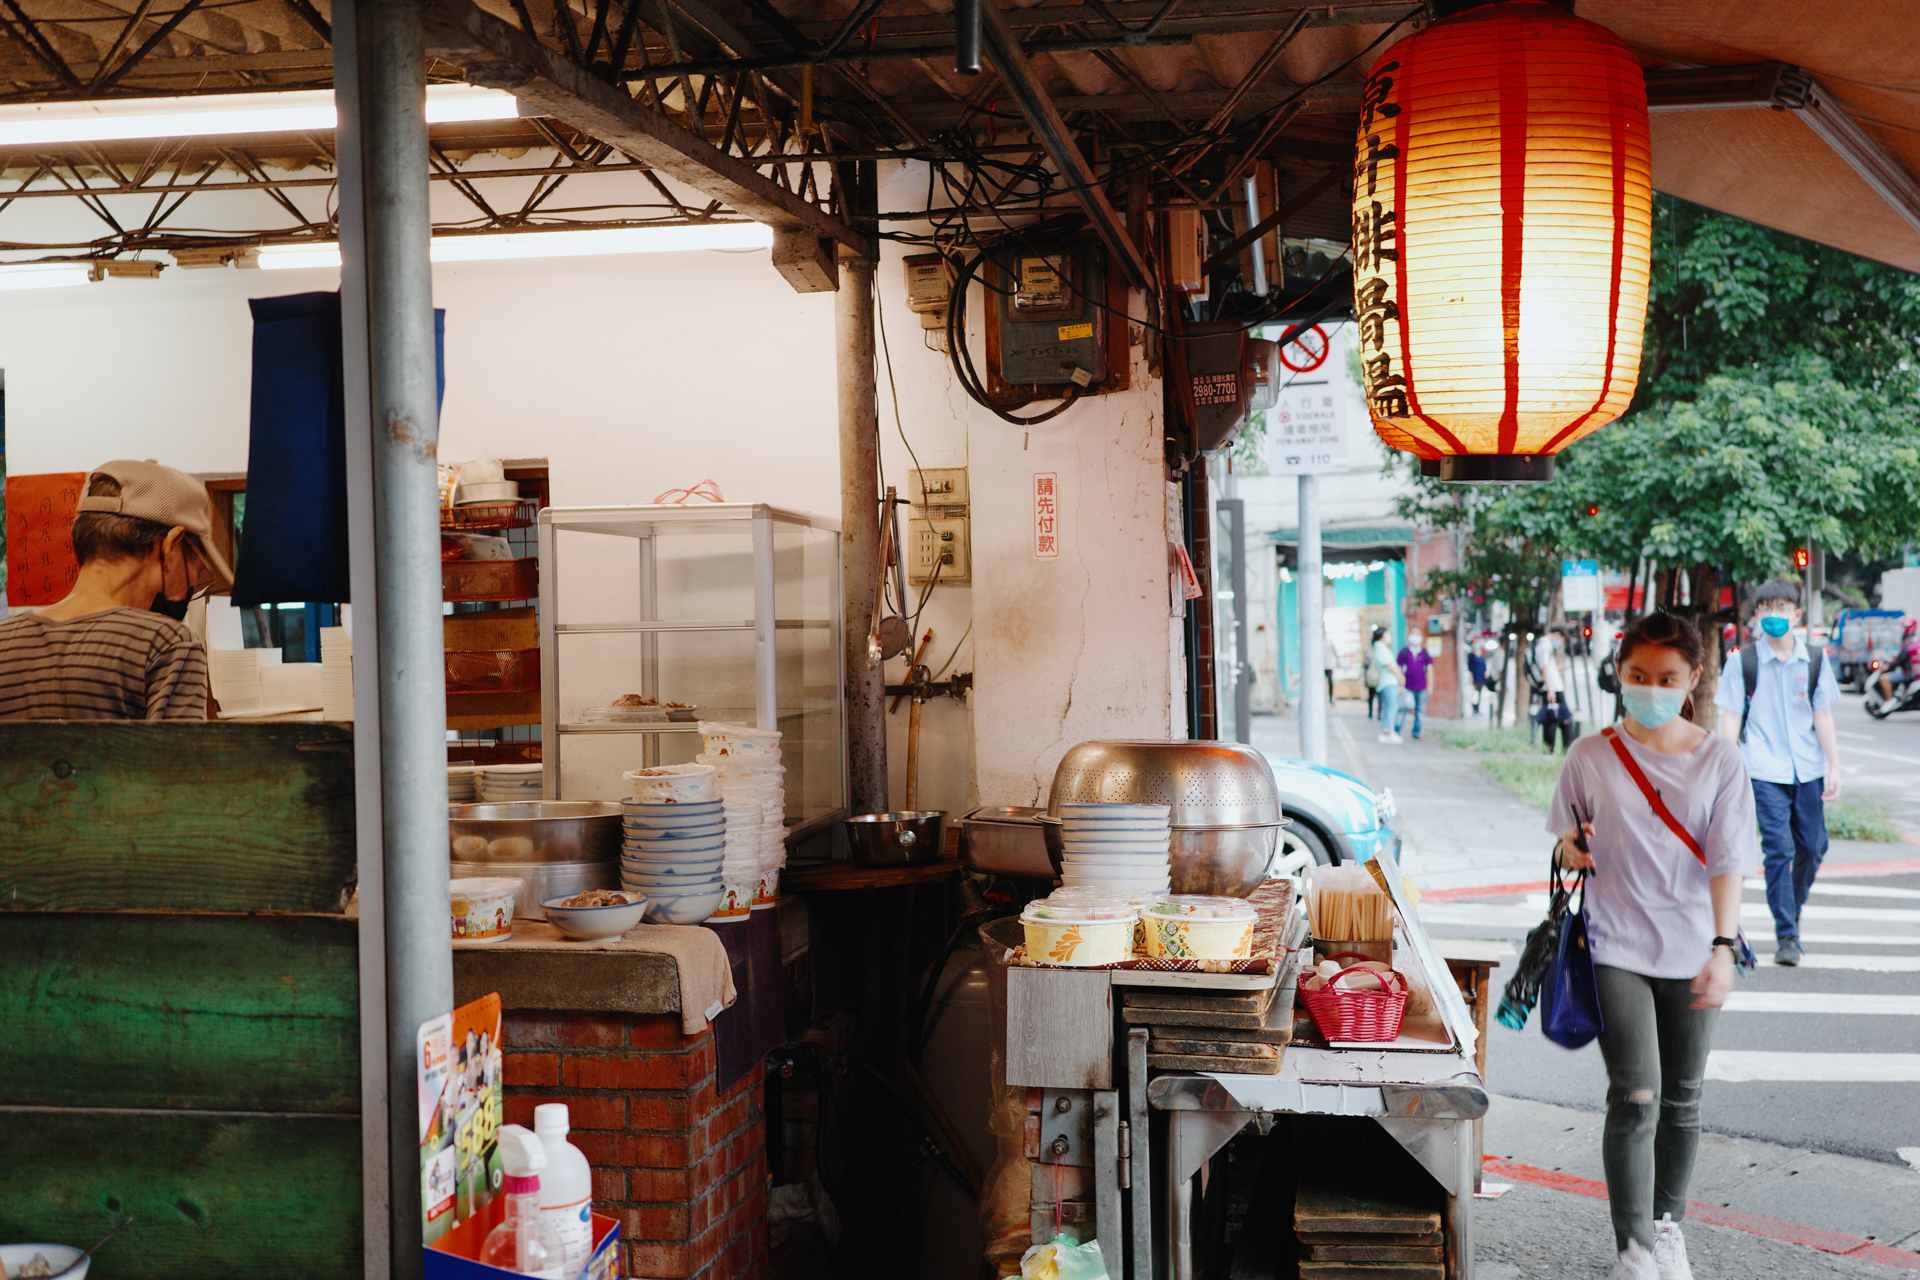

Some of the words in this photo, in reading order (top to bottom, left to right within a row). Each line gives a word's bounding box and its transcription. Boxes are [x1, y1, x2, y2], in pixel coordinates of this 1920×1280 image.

[1193, 382, 1236, 398] 2980-7700
[1280, 396, 1333, 409] 人行道
[1295, 411, 1336, 420] SIDEWALK
[1276, 436, 1316, 446] TOW-AWAY
[1319, 435, 1339, 444] ZONE
[1311, 453, 1331, 465] 110
[1037, 477, 1055, 553] 請先付款
